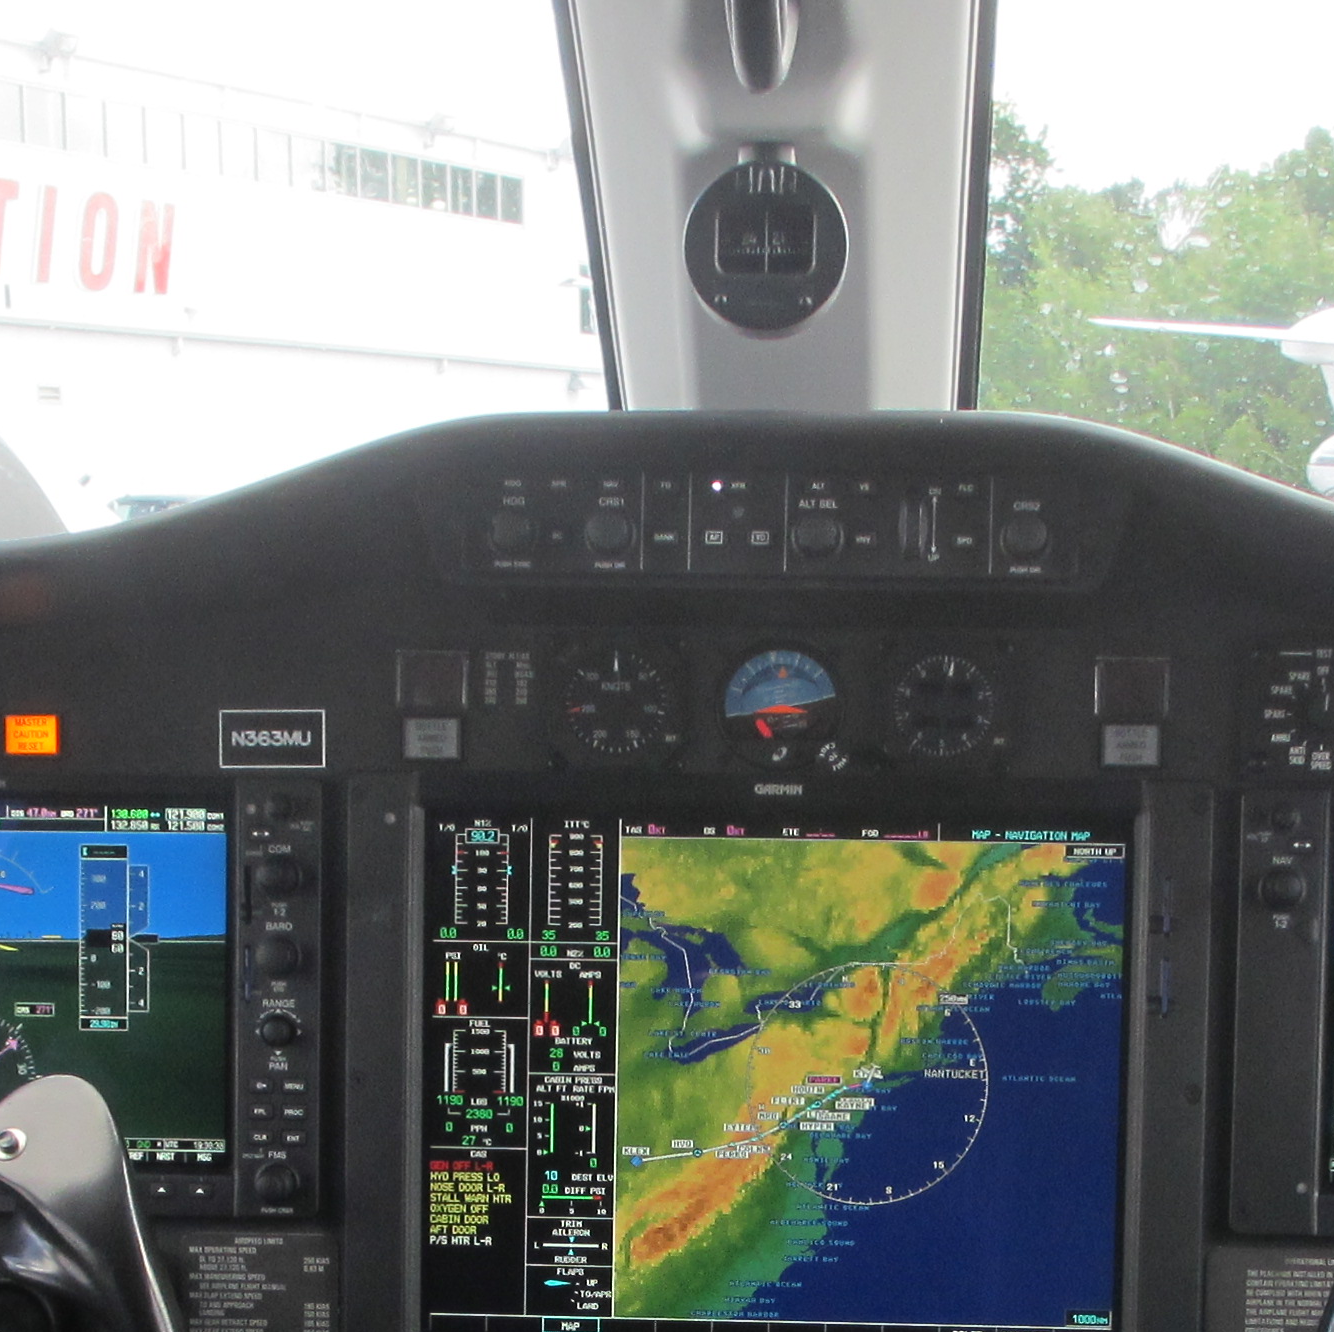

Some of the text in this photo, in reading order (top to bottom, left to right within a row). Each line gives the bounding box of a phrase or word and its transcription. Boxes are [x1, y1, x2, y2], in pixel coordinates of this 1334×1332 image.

[232, 731, 311, 746] N363MU
[755, 784, 803, 795] GARMIN
[972, 831, 1090, 840] MAP NAVIGATION MAP
[262, 999, 295, 1008] RANGE
[269, 1062, 288, 1071] PAN
[924, 1069, 986, 1079] NANTUCKET
[573, 1085, 593, 1093] RATE
[437, 1095, 524, 1106] 1190 1190
[462, 1136, 475, 1145] 27
[430, 1162, 493, 1170] GEN OFF L-R
[430, 1172, 499, 1181] HYD PRESS LO
[430, 1183, 505, 1192] NOSE DOOR L-R
[430, 1194, 459, 1202] STALL
[493, 1195, 511, 1203] HTR
[430, 1204, 488, 1213] OXYGEN OFF
[430, 1215, 488, 1224] CABIN DOOR
[430, 1226, 477, 1234] AFT DOOR
[430, 1236, 492, 1245] P/S HTR L-R
[557, 1268, 584, 1276] FLAPS
[561, 1322, 580, 1330] MAP
